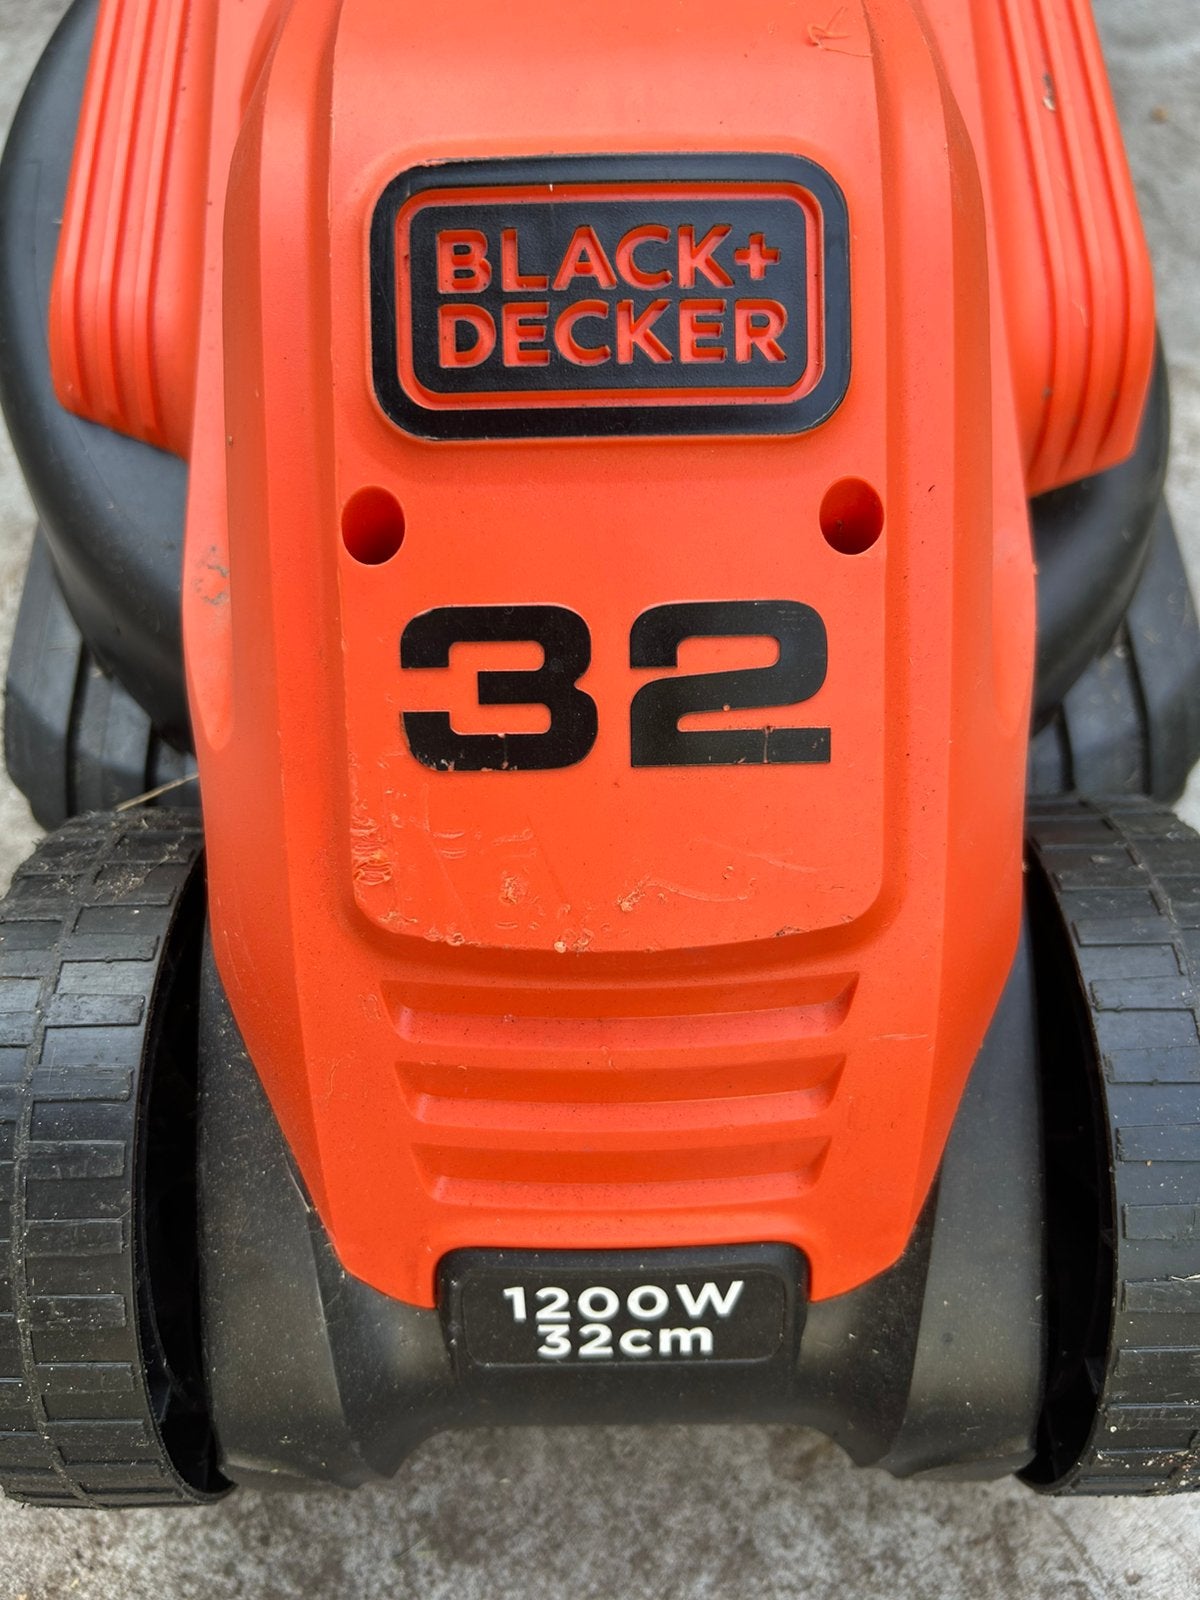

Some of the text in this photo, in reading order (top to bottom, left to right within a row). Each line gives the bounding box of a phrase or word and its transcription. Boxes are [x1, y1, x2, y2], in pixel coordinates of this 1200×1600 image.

[436, 224, 782, 294] BLACK+
[437, 298, 788, 368] DECKER
[400, 599, 831, 772] 32
[502, 1280, 744, 1323] 1200W
[536, 1323, 714, 1358] 32cm
